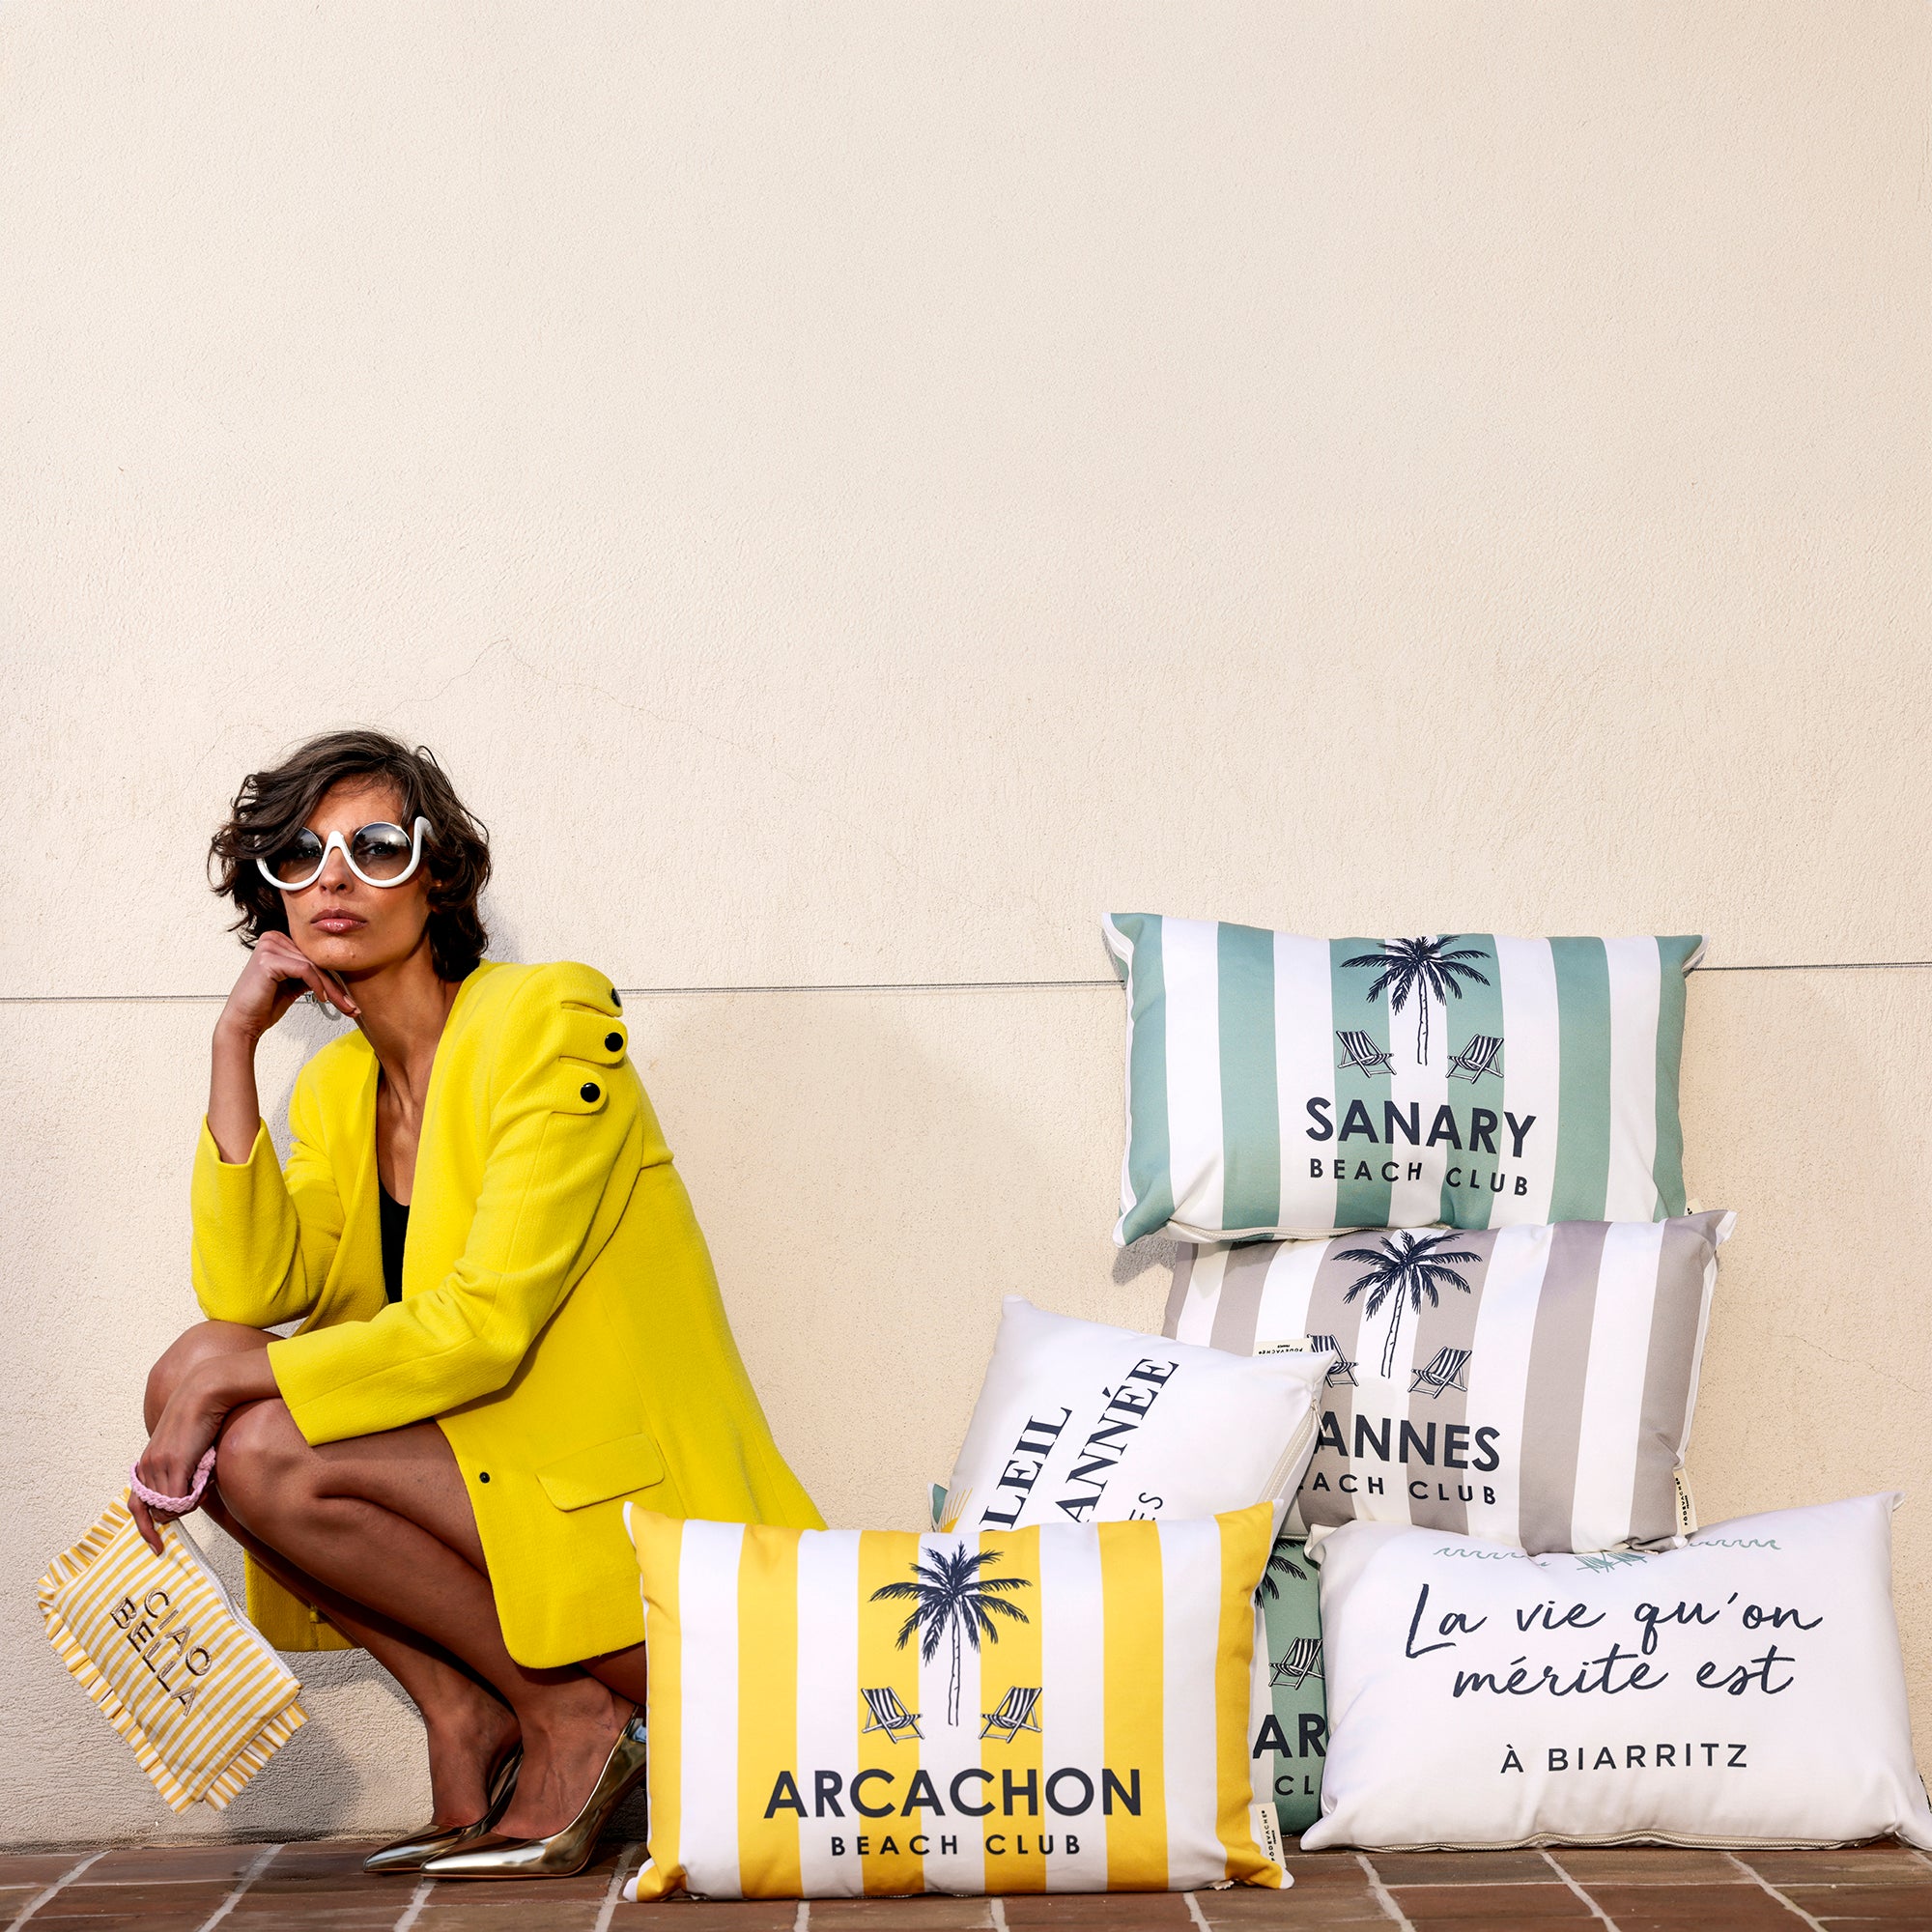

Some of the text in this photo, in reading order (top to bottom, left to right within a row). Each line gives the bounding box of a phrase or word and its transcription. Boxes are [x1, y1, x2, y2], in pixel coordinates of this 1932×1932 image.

[1306, 1096, 1537, 1158] SANARY
[1311, 1159, 1526, 1195] BEACH CLUB
[1314, 1410, 1501, 1472] ANNES
[979, 1406, 1073, 1531] LEIL
[1296, 1471, 1496, 1505] ACH CLUB
[144, 1589, 212, 1676] CIAO
[1406, 1584, 1824, 1658] La vie qu'on
[110, 1597, 196, 1717] BELLA
[1453, 1642, 1795, 1698] mérite est
[1252, 1713, 1326, 1759] AR
[1500, 1744, 1747, 1774] À BIARRITZ
[764, 1768, 1140, 1818] ARCACHON
[1274, 1775, 1315, 1796] CL
[832, 1834, 1079, 1856] BEACH CLUB
